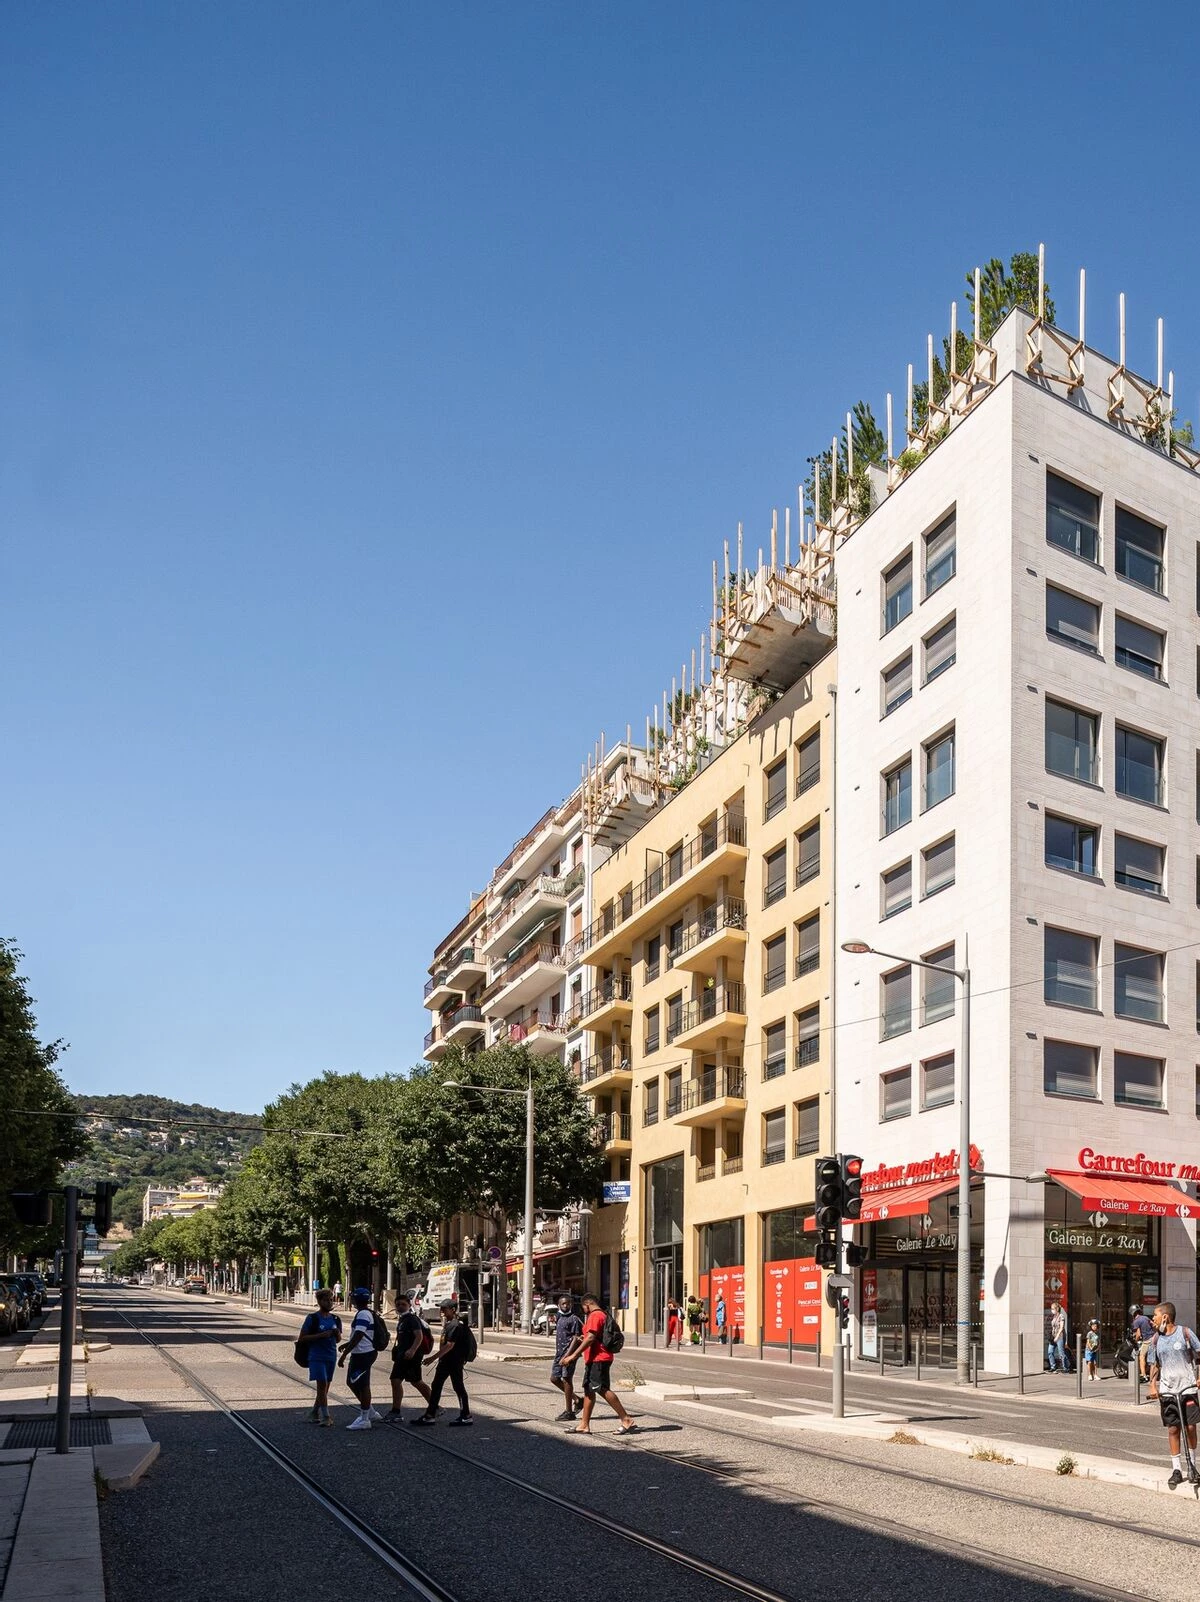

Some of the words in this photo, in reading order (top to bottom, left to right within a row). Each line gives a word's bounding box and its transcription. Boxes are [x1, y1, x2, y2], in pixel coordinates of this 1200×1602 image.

[905, 1149, 957, 1178] market
[1078, 1148, 1176, 1178] Carrefour
[1100, 1199, 1129, 1211] Galerie
[1138, 1202, 1149, 1212] Le
[1150, 1204, 1167, 1215] Ray
[896, 1238, 922, 1251] Galerie
[925, 1236, 936, 1249] Le
[938, 1233, 957, 1250] Ray
[1049, 1231, 1093, 1246] Galerie
[1097, 1234, 1115, 1248] Le
[1117, 1235, 1145, 1254] Ray
